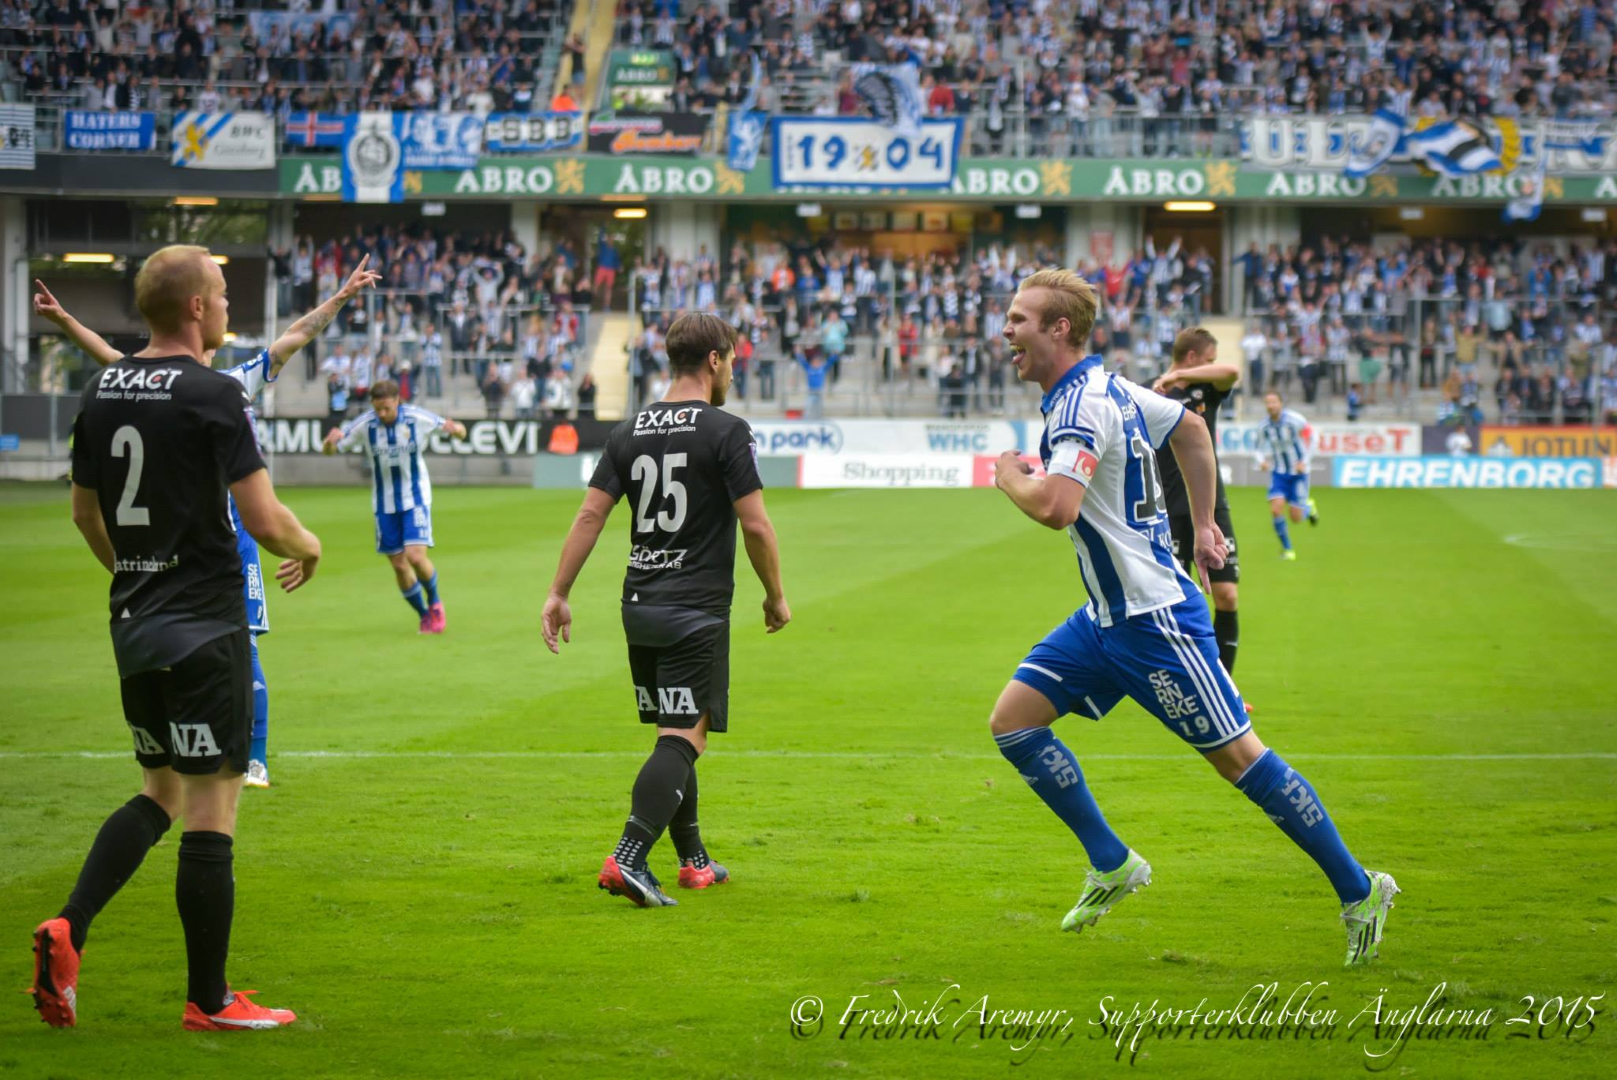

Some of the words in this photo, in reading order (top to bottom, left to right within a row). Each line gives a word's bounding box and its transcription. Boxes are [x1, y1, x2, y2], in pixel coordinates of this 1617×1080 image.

[797, 134, 847, 170] 19
[886, 136, 943, 170] 04
[98, 367, 183, 390] EXACT
[96, 390, 122, 399] Passion
[123, 390, 135, 400] for
[135, 391, 172, 403] precision
[634, 407, 703, 429] EXACT
[633, 428, 656, 436] Passion
[667, 424, 696, 436] precision
[771, 426, 835, 452] park
[927, 433, 988, 451] WHC
[111, 425, 150, 526] 2
[843, 462, 959, 486] Shopping
[1339, 460, 1595, 488] EHRENBORG
[631, 452, 688, 533] 25
[1148, 669, 1174, 689] SE
[1155, 682, 1184, 705] RN
[1179, 715, 1210, 737] 19
